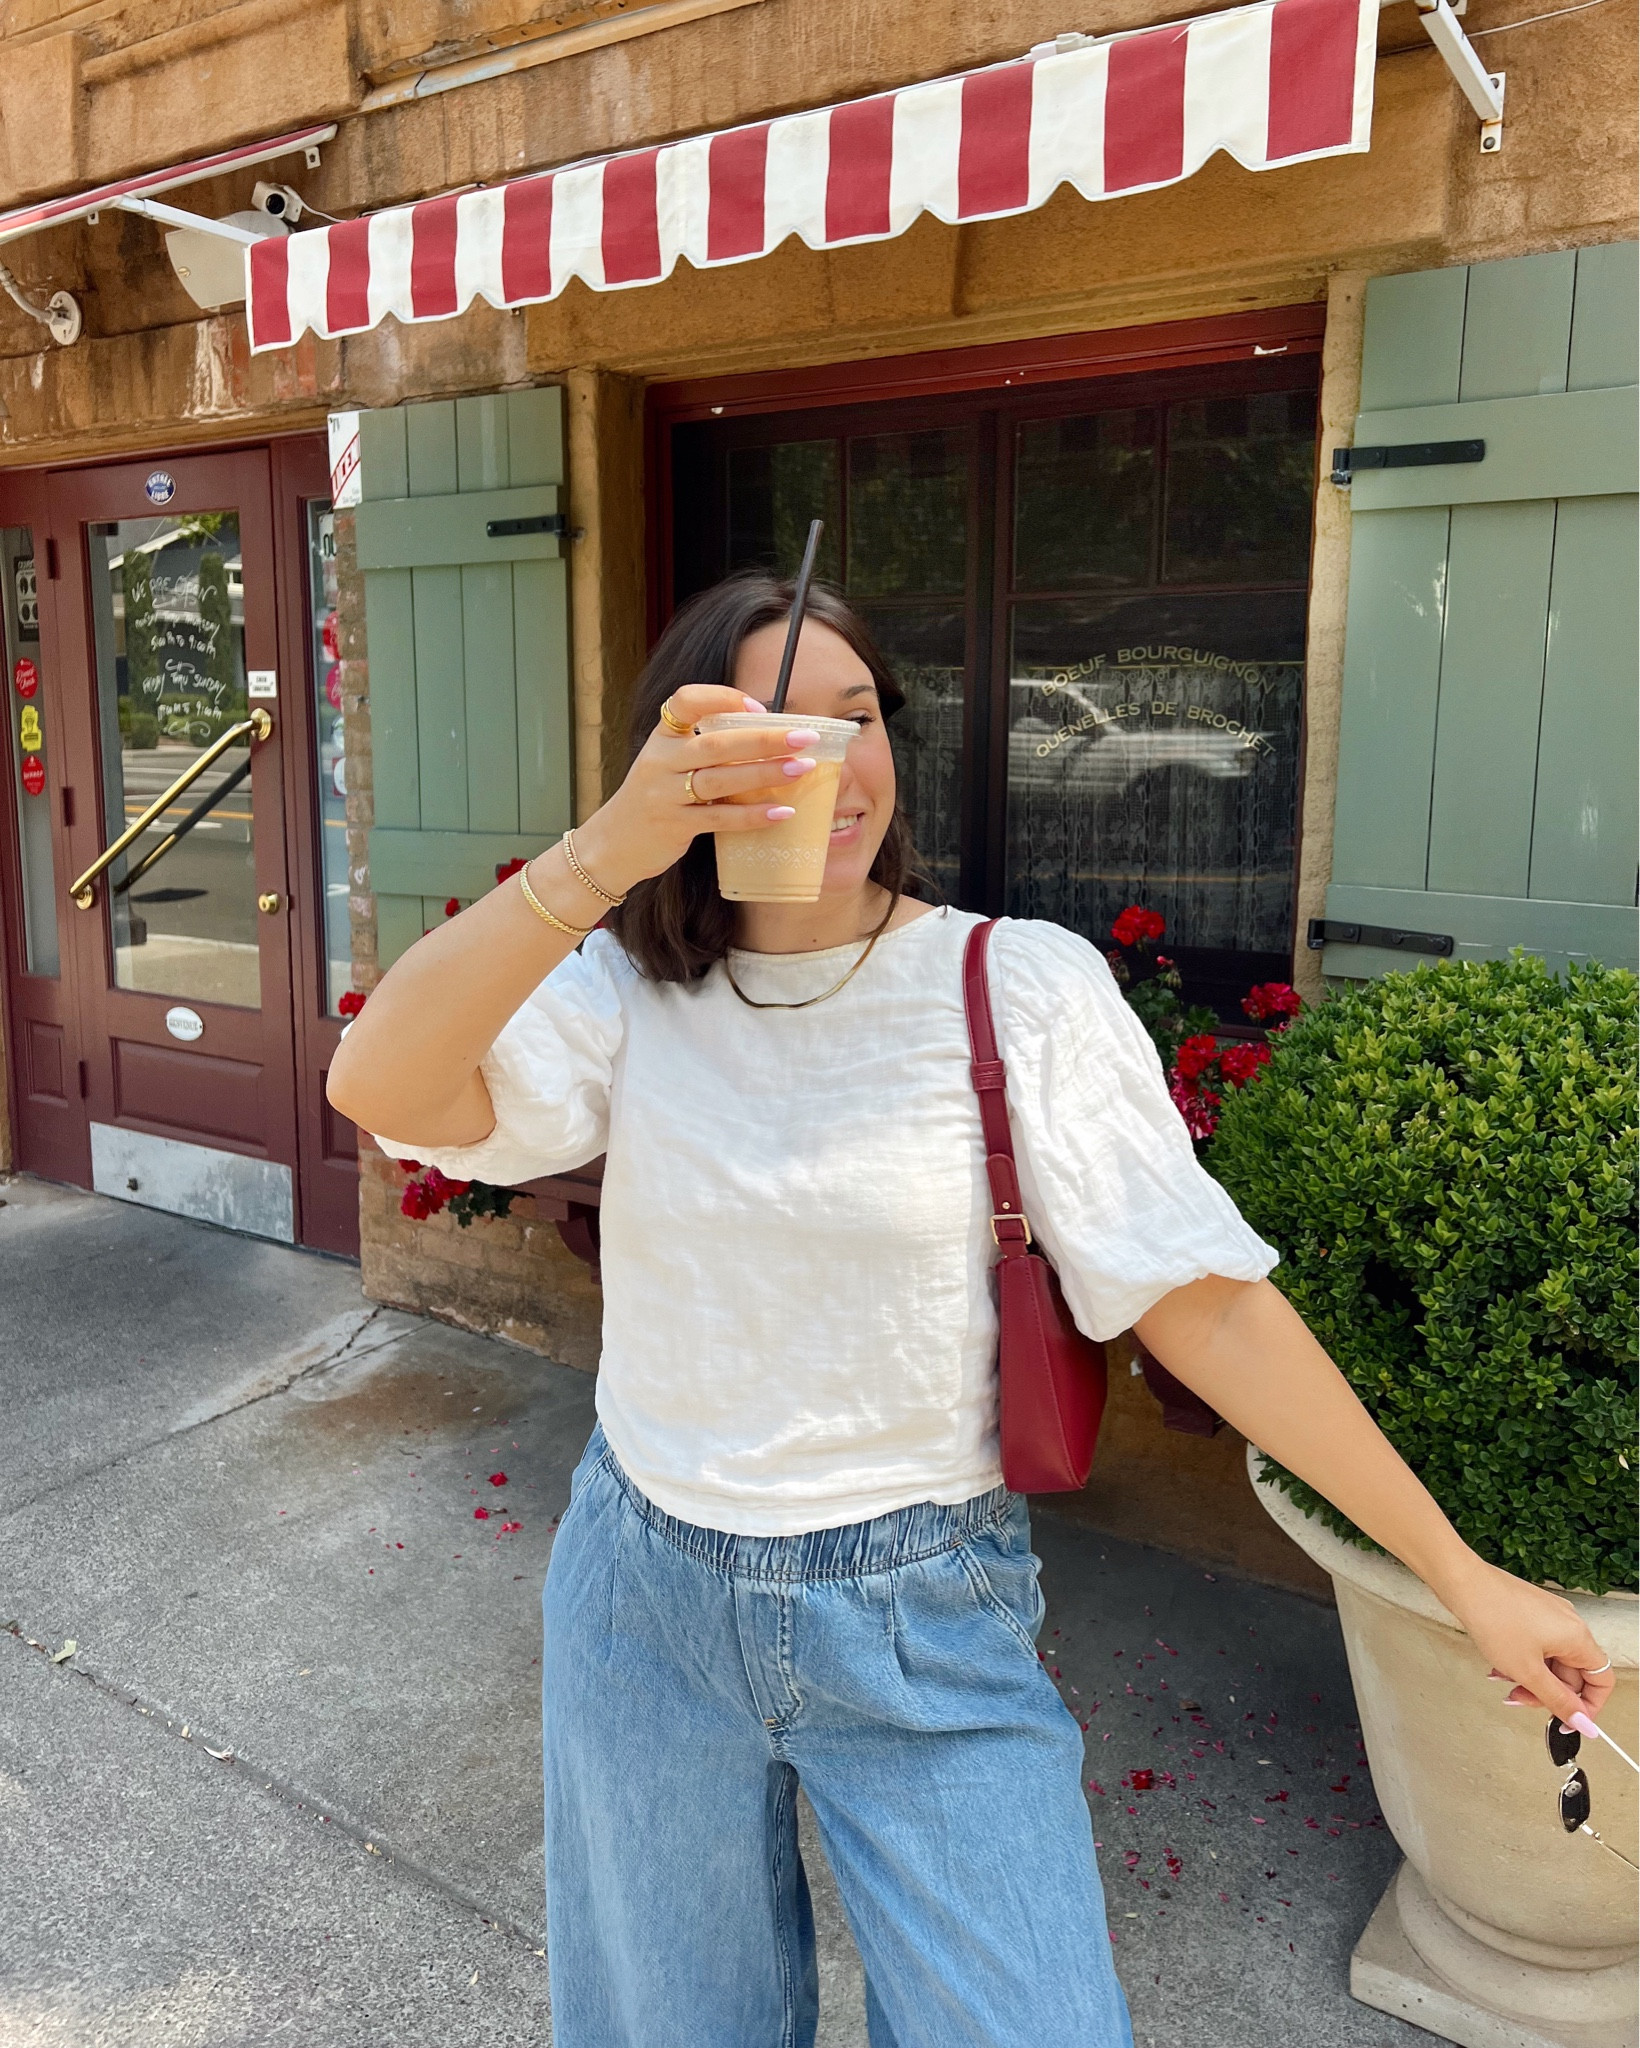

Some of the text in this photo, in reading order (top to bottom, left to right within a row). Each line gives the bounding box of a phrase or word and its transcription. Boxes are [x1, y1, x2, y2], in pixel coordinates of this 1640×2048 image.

[131, 570, 218, 608] WE ARE OPEN
[192, 673, 226, 705] SUNDAY
[1041, 645, 1276, 697] BOEUF BOURGUIGNON
[1036, 701, 1276, 758] QUENELLES DE BROCHET
